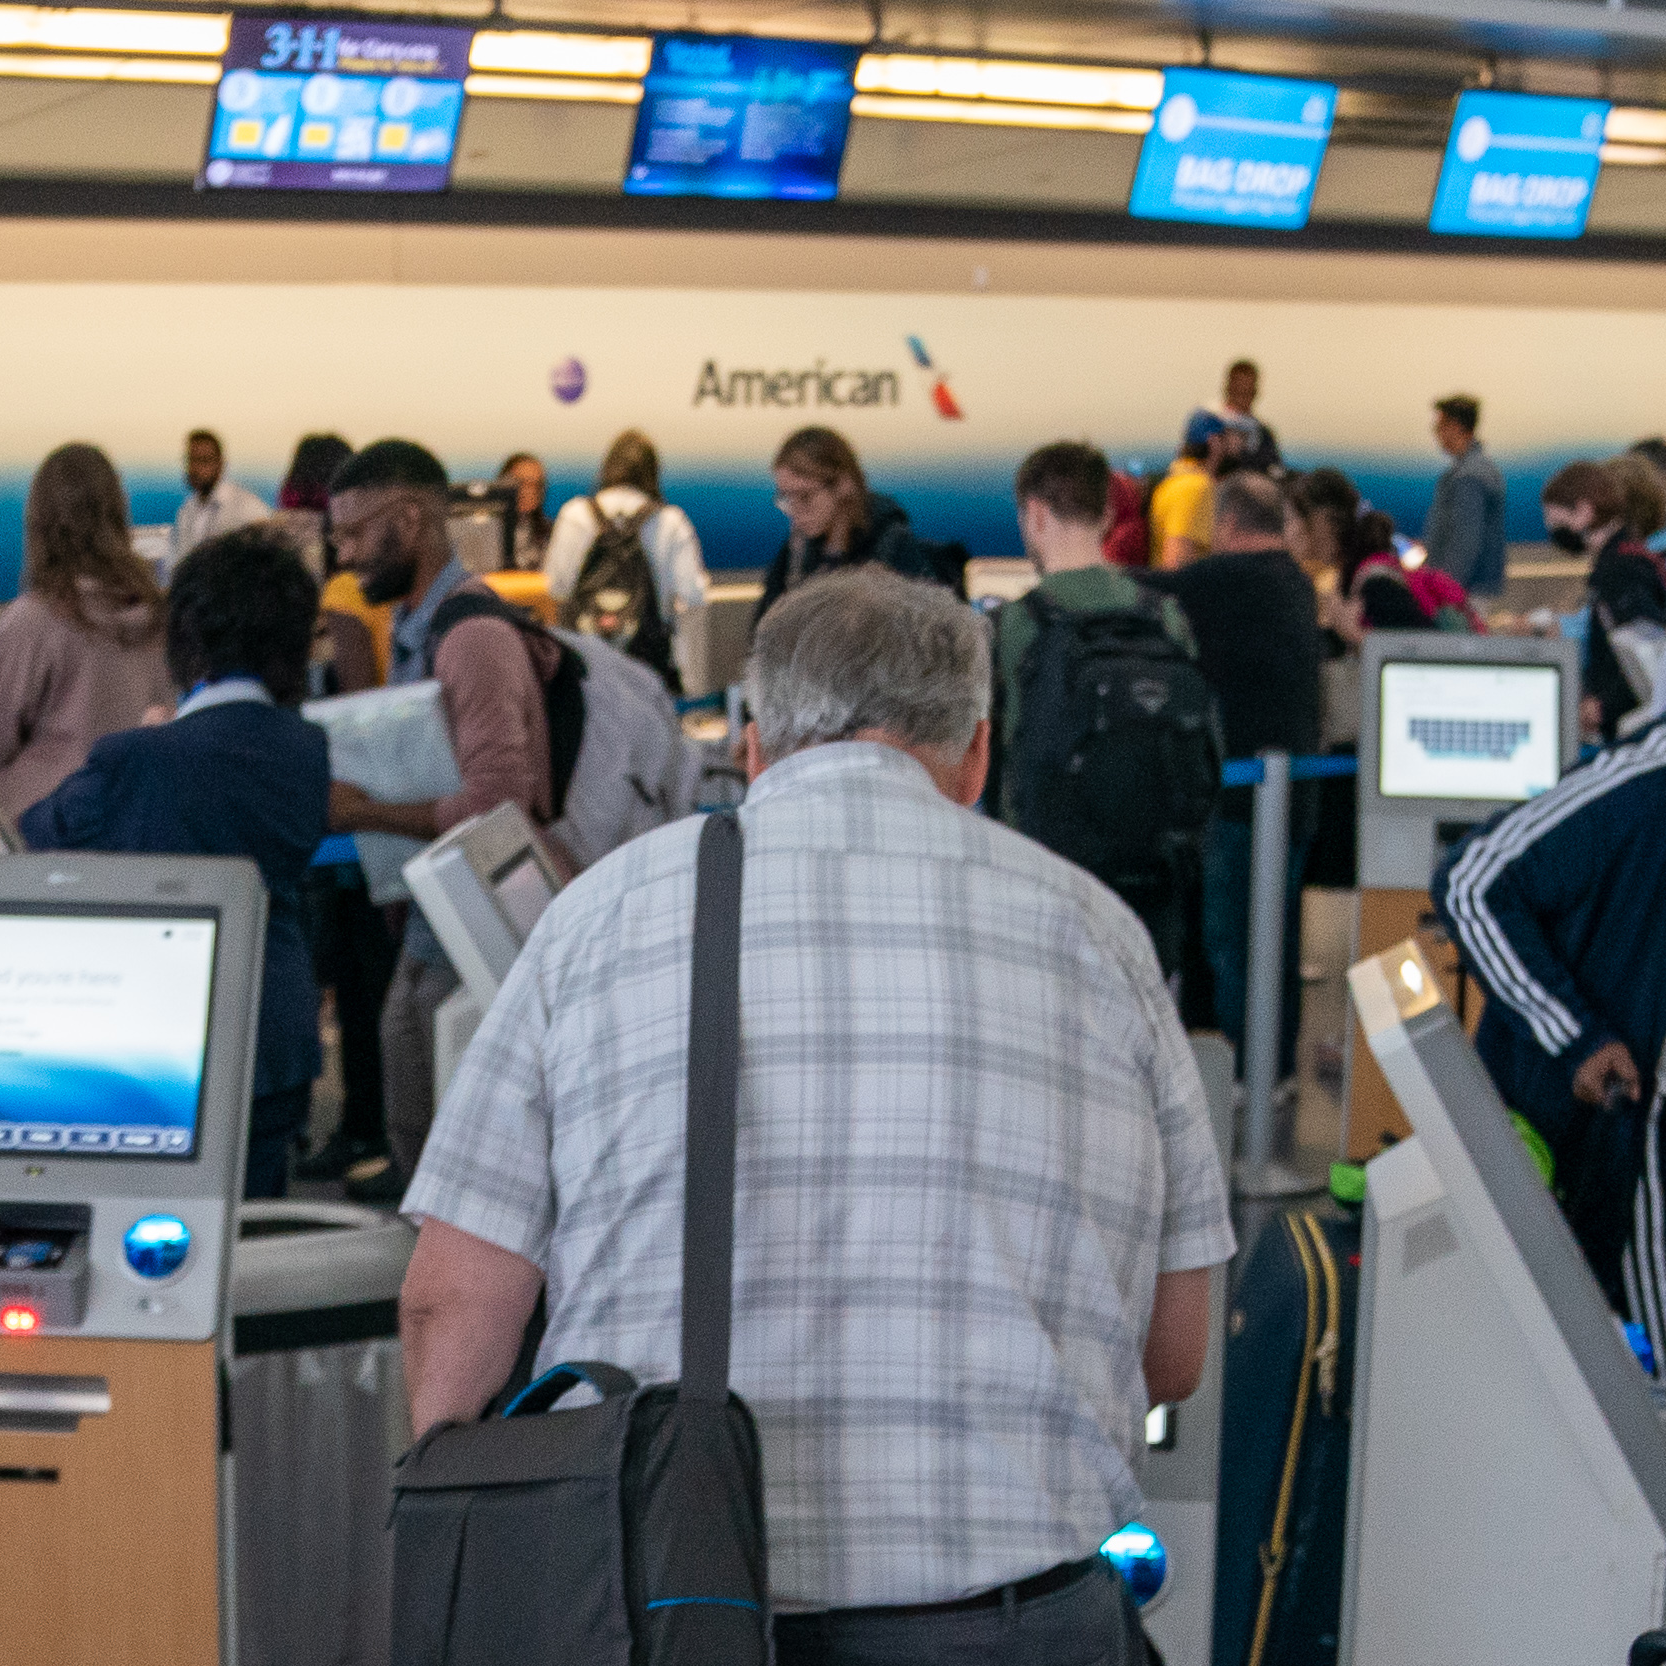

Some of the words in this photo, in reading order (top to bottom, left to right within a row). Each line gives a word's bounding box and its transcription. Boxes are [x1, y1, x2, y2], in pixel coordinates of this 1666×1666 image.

[1175, 155, 1234, 193] BAG
[1236, 160, 1312, 198] DROP
[692, 357, 901, 408] American
